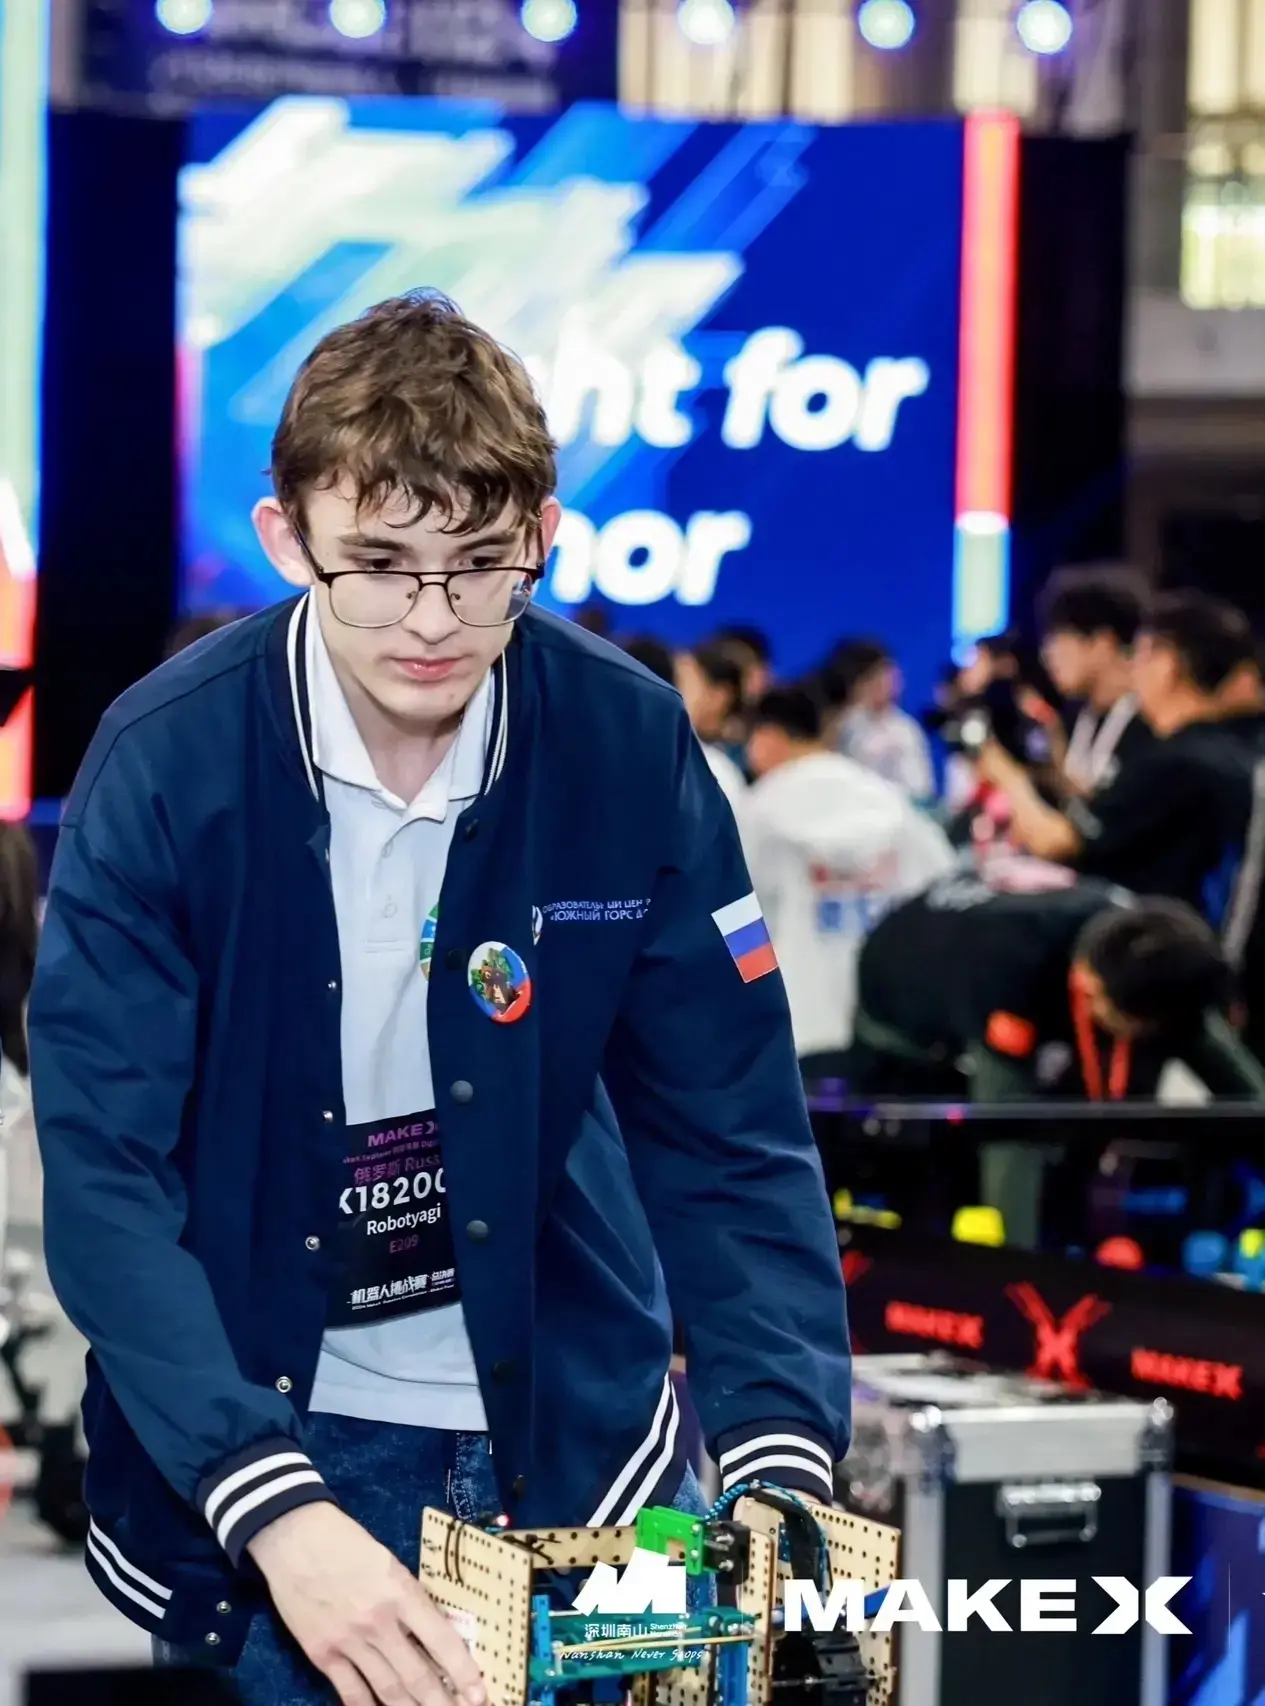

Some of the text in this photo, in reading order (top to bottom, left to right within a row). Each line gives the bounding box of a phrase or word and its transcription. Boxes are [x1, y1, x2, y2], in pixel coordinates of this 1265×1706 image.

[523, 308, 931, 452] ht for
[354, 1160, 400, 1185] 俄罗斯
[366, 1203, 442, 1236] Robotyagi
[389, 1234, 419, 1254] E209
